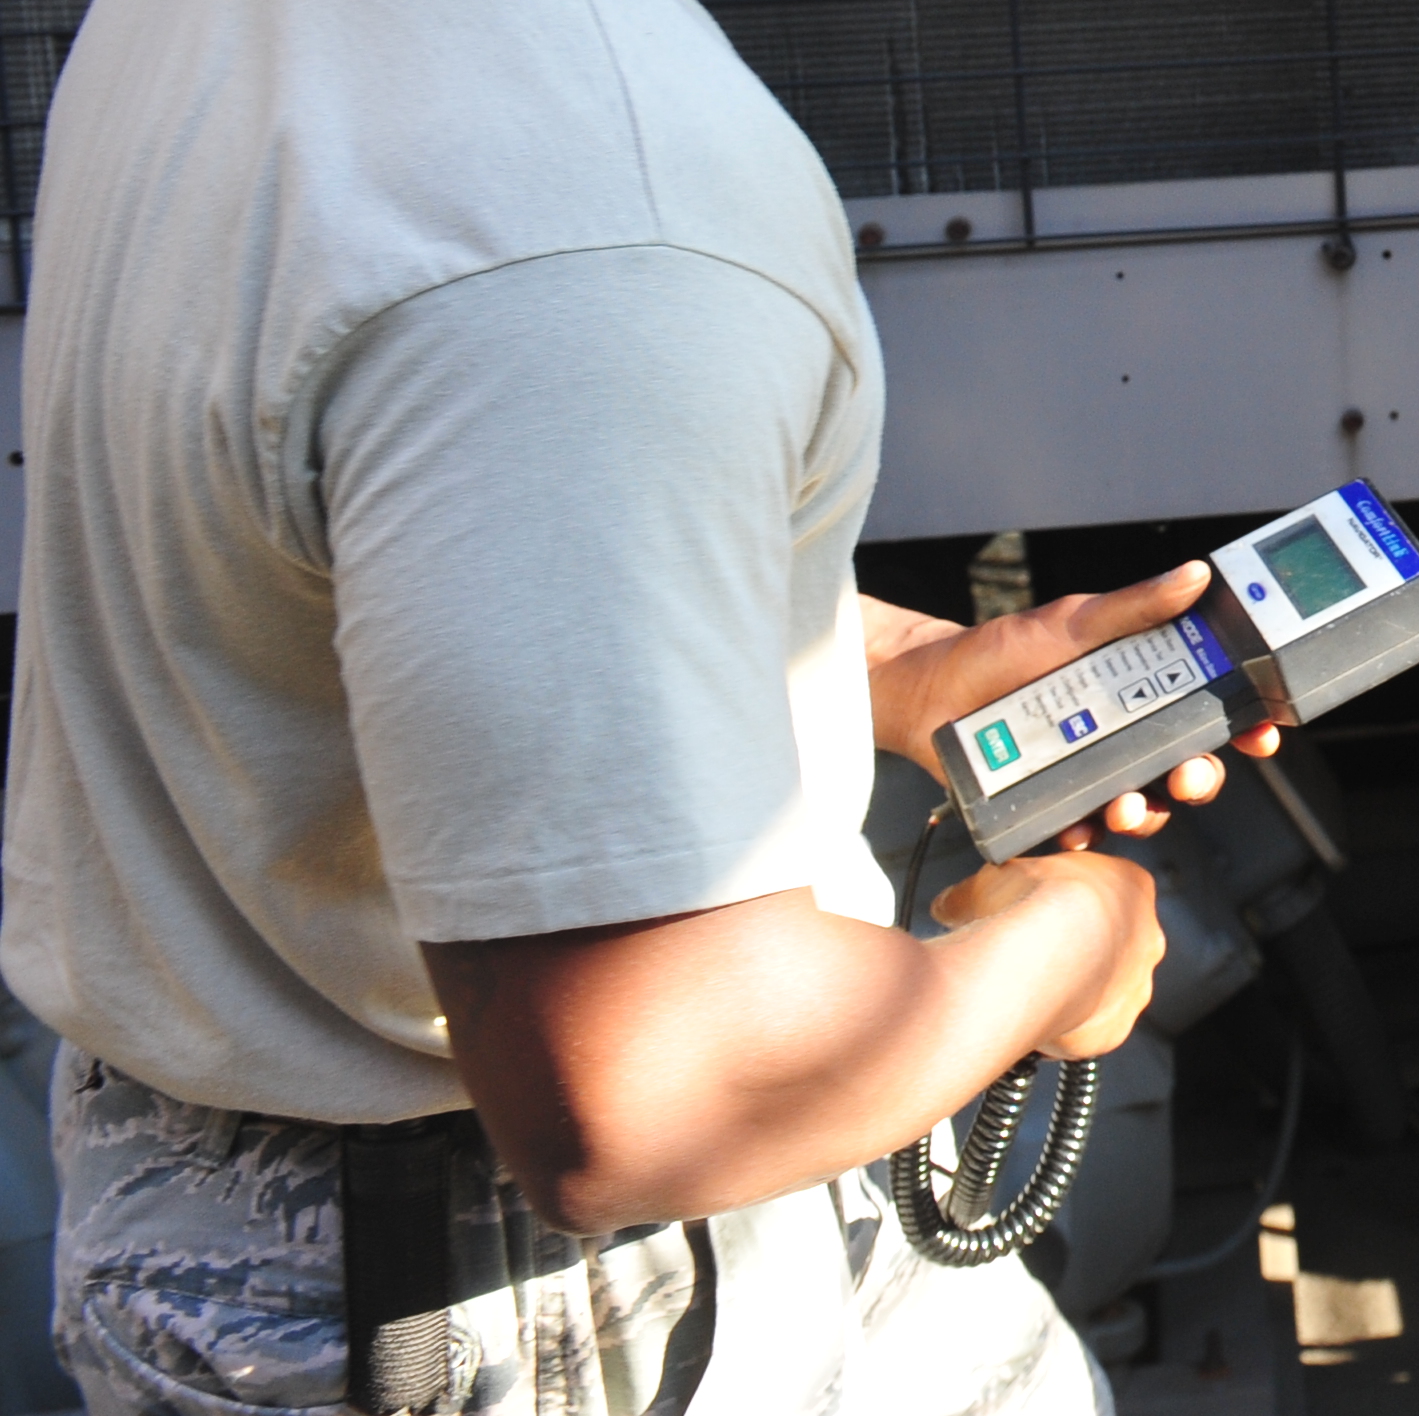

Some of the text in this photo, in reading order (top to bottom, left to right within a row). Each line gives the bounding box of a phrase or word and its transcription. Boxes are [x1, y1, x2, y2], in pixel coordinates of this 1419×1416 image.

[1347, 517, 1381, 559] NAVIGATOR
[1356, 498, 1409, 559] ComfortLink
[984, 727, 1010, 764] ENTER
[1066, 714, 1089, 739] ESC
